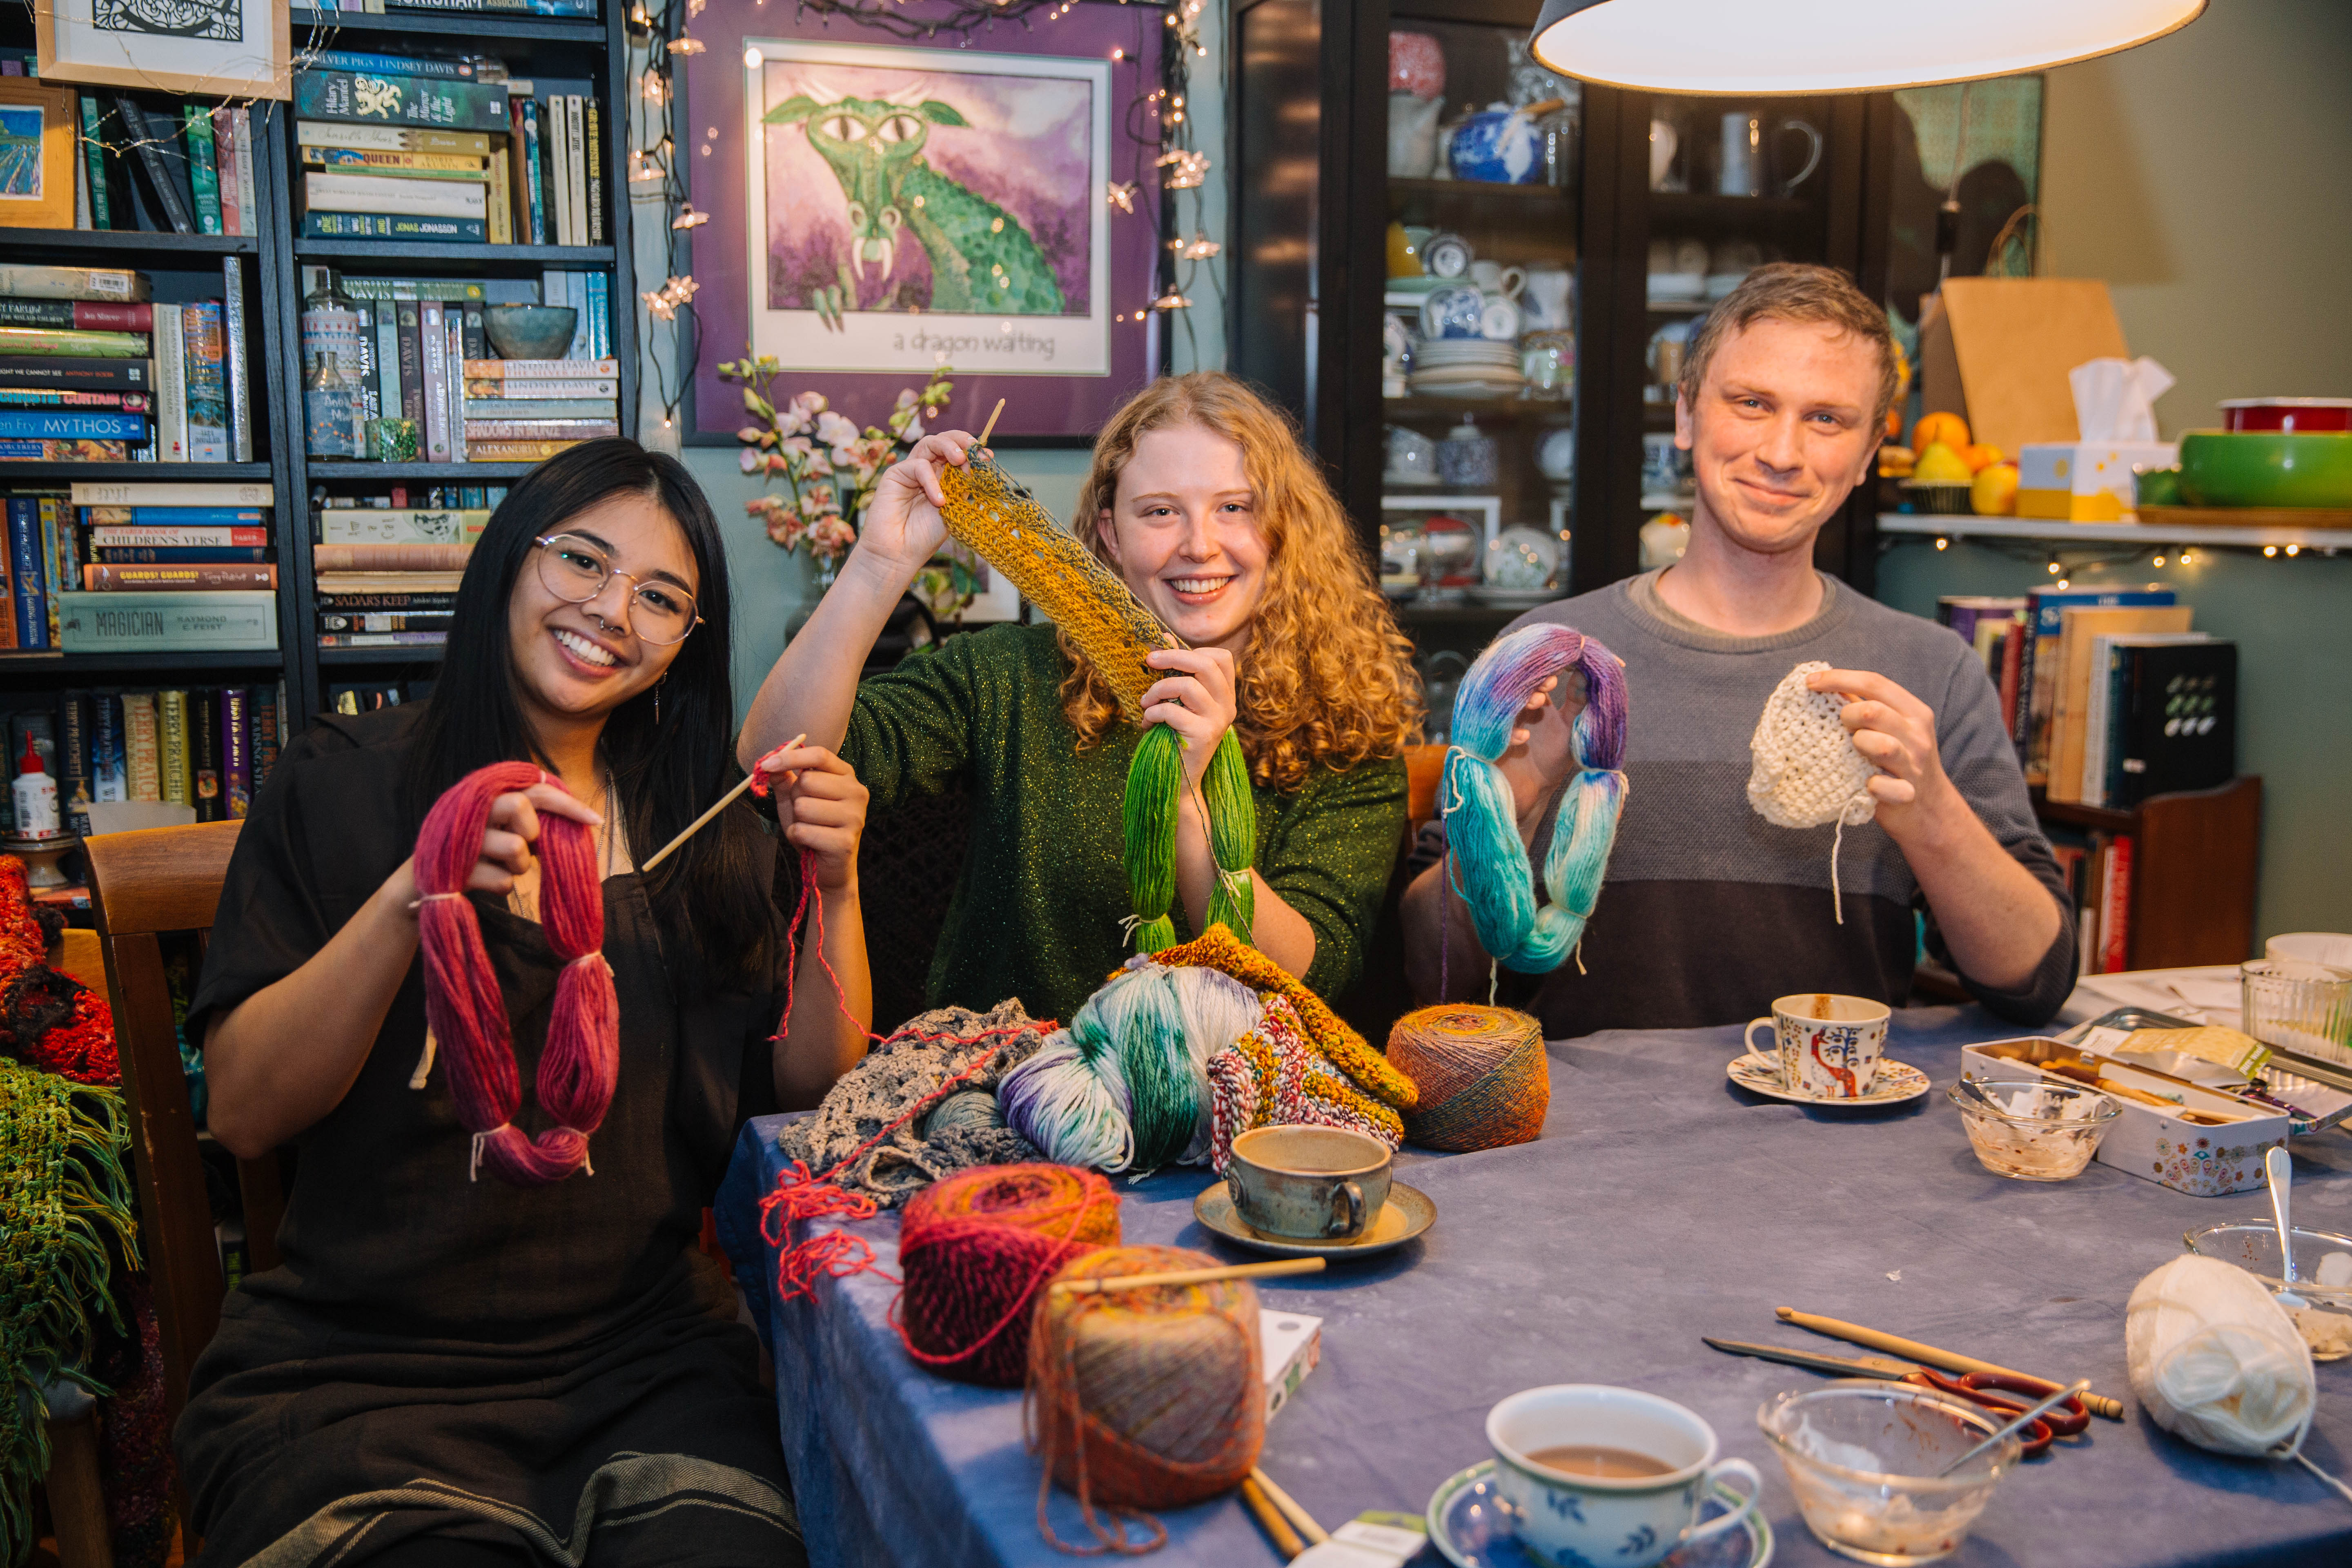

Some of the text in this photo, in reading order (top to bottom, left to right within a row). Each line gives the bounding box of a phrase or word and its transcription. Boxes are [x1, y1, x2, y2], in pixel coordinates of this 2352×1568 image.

[352, 57, 374, 68] PIGS
[380, 58, 421, 72] LINDSEY
[425, 62, 454, 75] DAVIS
[326, 82, 339, 114] Hilary
[339, 79, 350, 116] Mantel
[407, 102, 419, 119] The
[442, 96, 456, 122] Light
[363, 154, 400, 164] QUEEN
[395, 222, 419, 232] JONAS
[419, 224, 457, 234] JONASSON
[893, 327, 1055, 361] a dragon waiting
[359, 336, 370, 376] DAVIS
[401, 337, 412, 376] DAVIS
[506, 361, 597, 370] LINDSEY DAVIS
[506, 381, 558, 389] LINDSEY
[63, 392, 120, 405] CURTAIN
[16, 419, 36, 434] Fry
[44, 419, 121, 434] MYTHOS
[476, 445, 539, 455] ALEXANDRIA
[103, 535, 223, 546] CHILDREN'S VERSE
[120, 571, 199, 579] GUARDS! GUARDS!
[382, 595, 411, 606] KEEP
[95, 611, 164, 637] MAGICIAN
[165, 699, 180, 738] TERRY
[261, 703, 277, 742] TERRY
[251, 716, 262, 765] RAISING
[134, 702, 158, 802] TERRY PRATCH
[2250, 1044, 2267, 1060] wool
